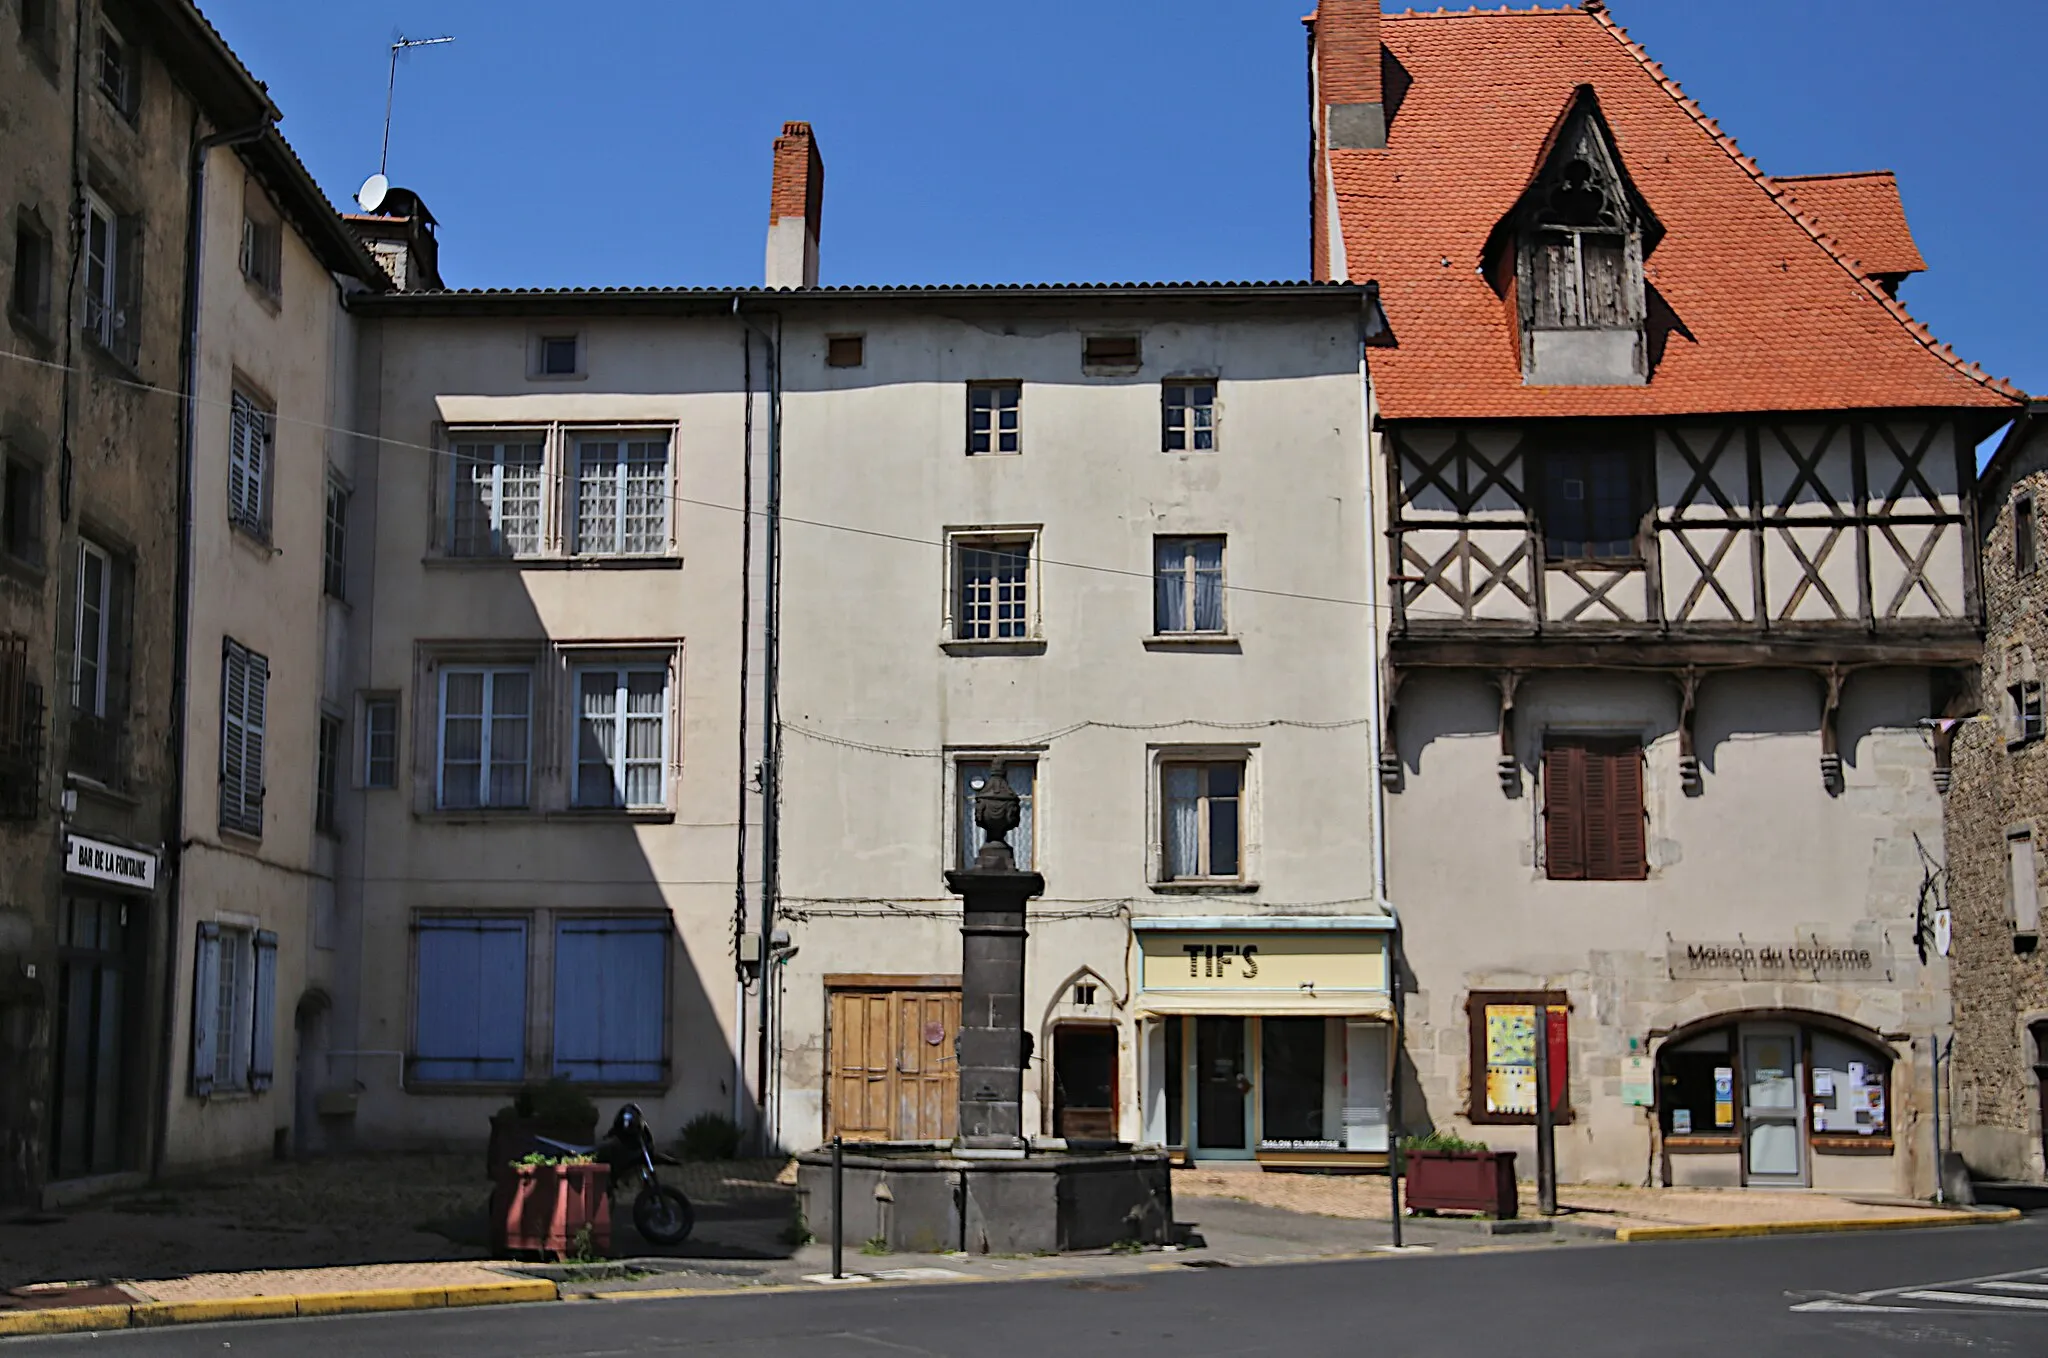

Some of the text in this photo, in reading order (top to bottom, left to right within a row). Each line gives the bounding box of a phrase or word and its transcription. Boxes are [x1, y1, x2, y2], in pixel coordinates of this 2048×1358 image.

[79, 845, 146, 880] BAR DE LA FONTAINE
[1183, 944, 1258, 978] TIF'S
[1687, 944, 1870, 961] Maison du tourisme
[1262, 1140, 1292, 1149] SALON
